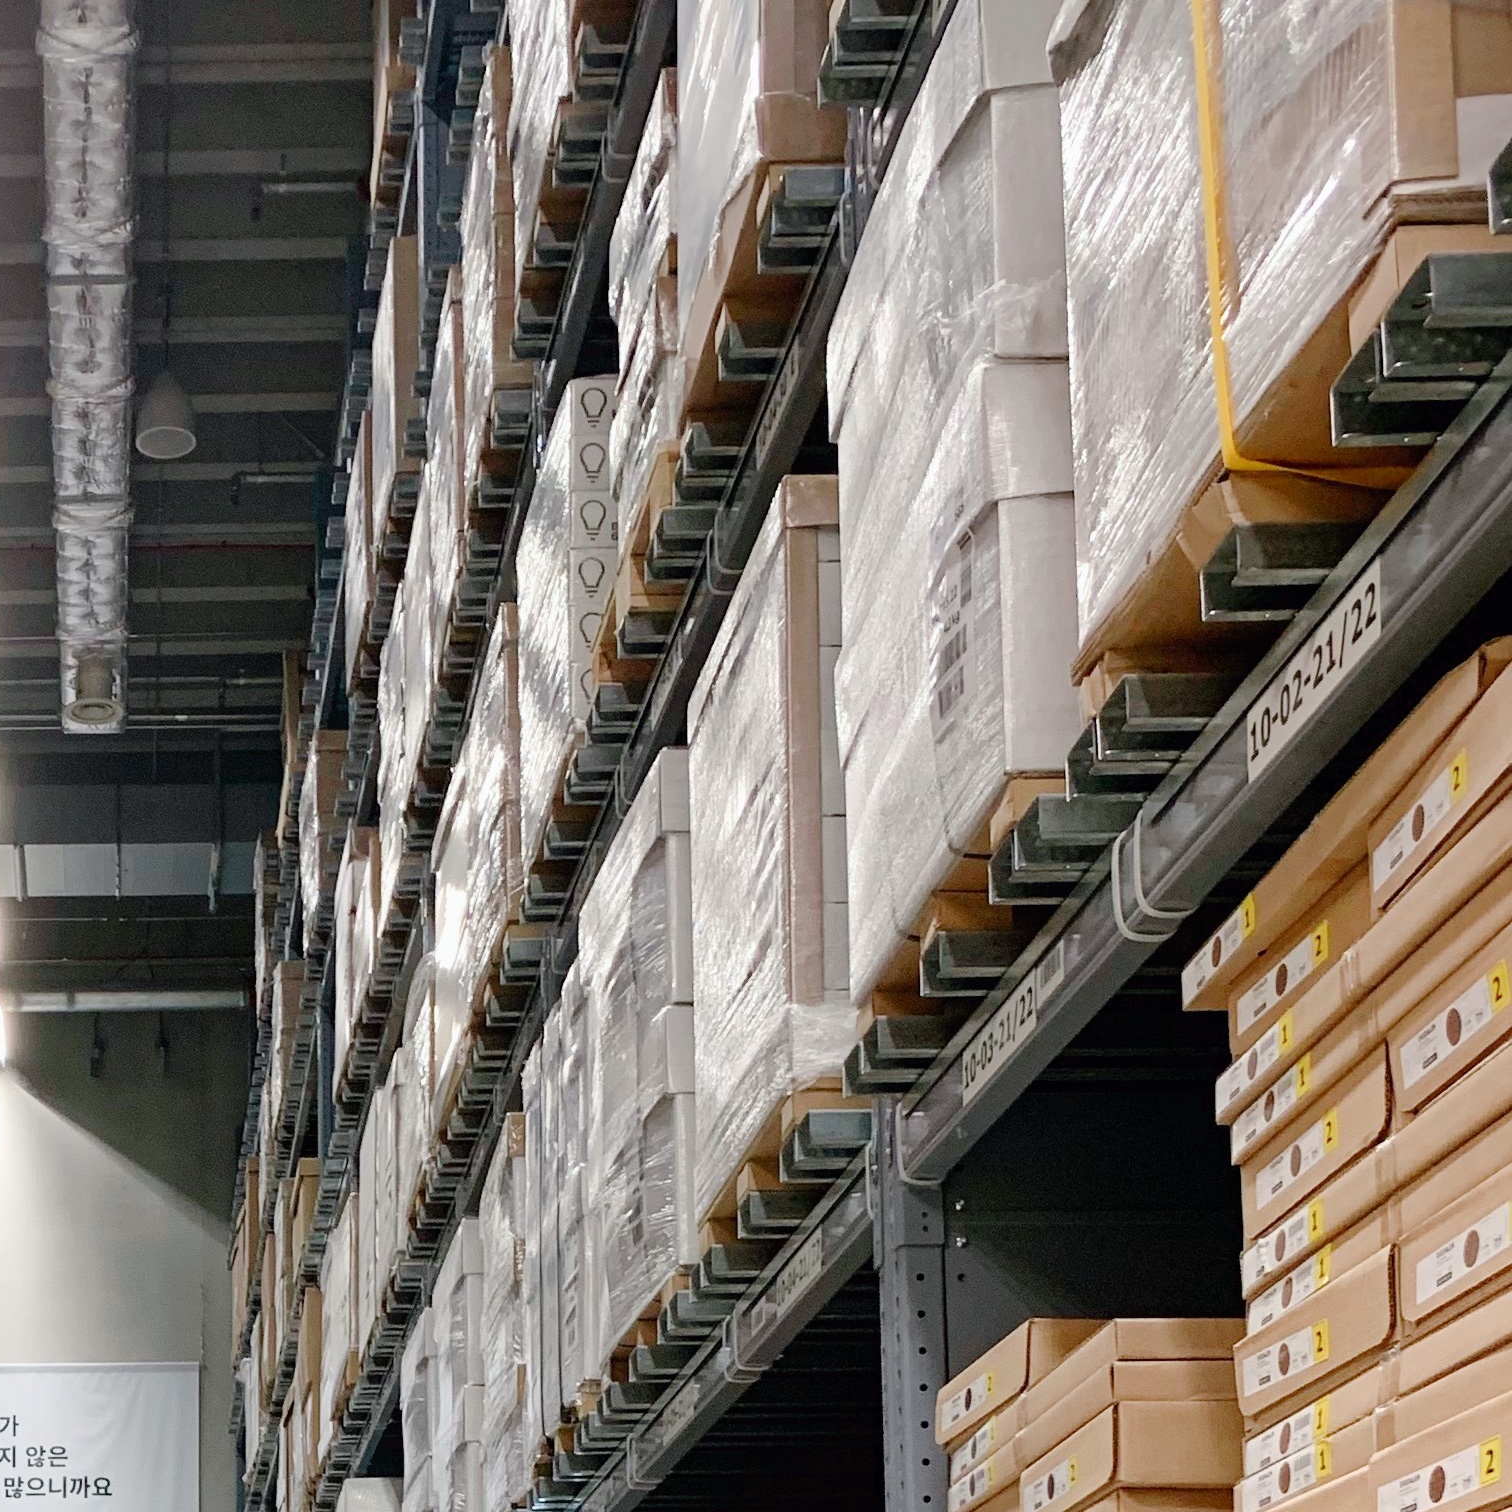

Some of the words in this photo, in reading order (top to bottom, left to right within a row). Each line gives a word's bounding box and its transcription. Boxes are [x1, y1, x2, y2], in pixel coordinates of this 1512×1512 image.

[1250, 582, 1377, 762] 10-02-21/22
[1452, 765, 1461, 792] 2
[1244, 907, 1250, 930] 1
[1313, 934, 1323, 957] 2
[1492, 976, 1503, 1003] 2
[964, 986, 1033, 1090] 10-03-21/22
[1281, 1023, 1288, 1045] 1
[1299, 1066, 1306, 1088] 1
[1311, 1209, 1318, 1232] 1
[1318, 1257, 1325, 1279] 1
[1315, 1330, 1324, 1353] 2
[1316, 1407, 1324, 1430] 1
[25, 1445, 69, 1468] 않은
[1318, 1449, 1326, 1471] 1
[1484, 1449, 1494, 1475] 2
[3, 1476, 113, 1499] 많으니까요
